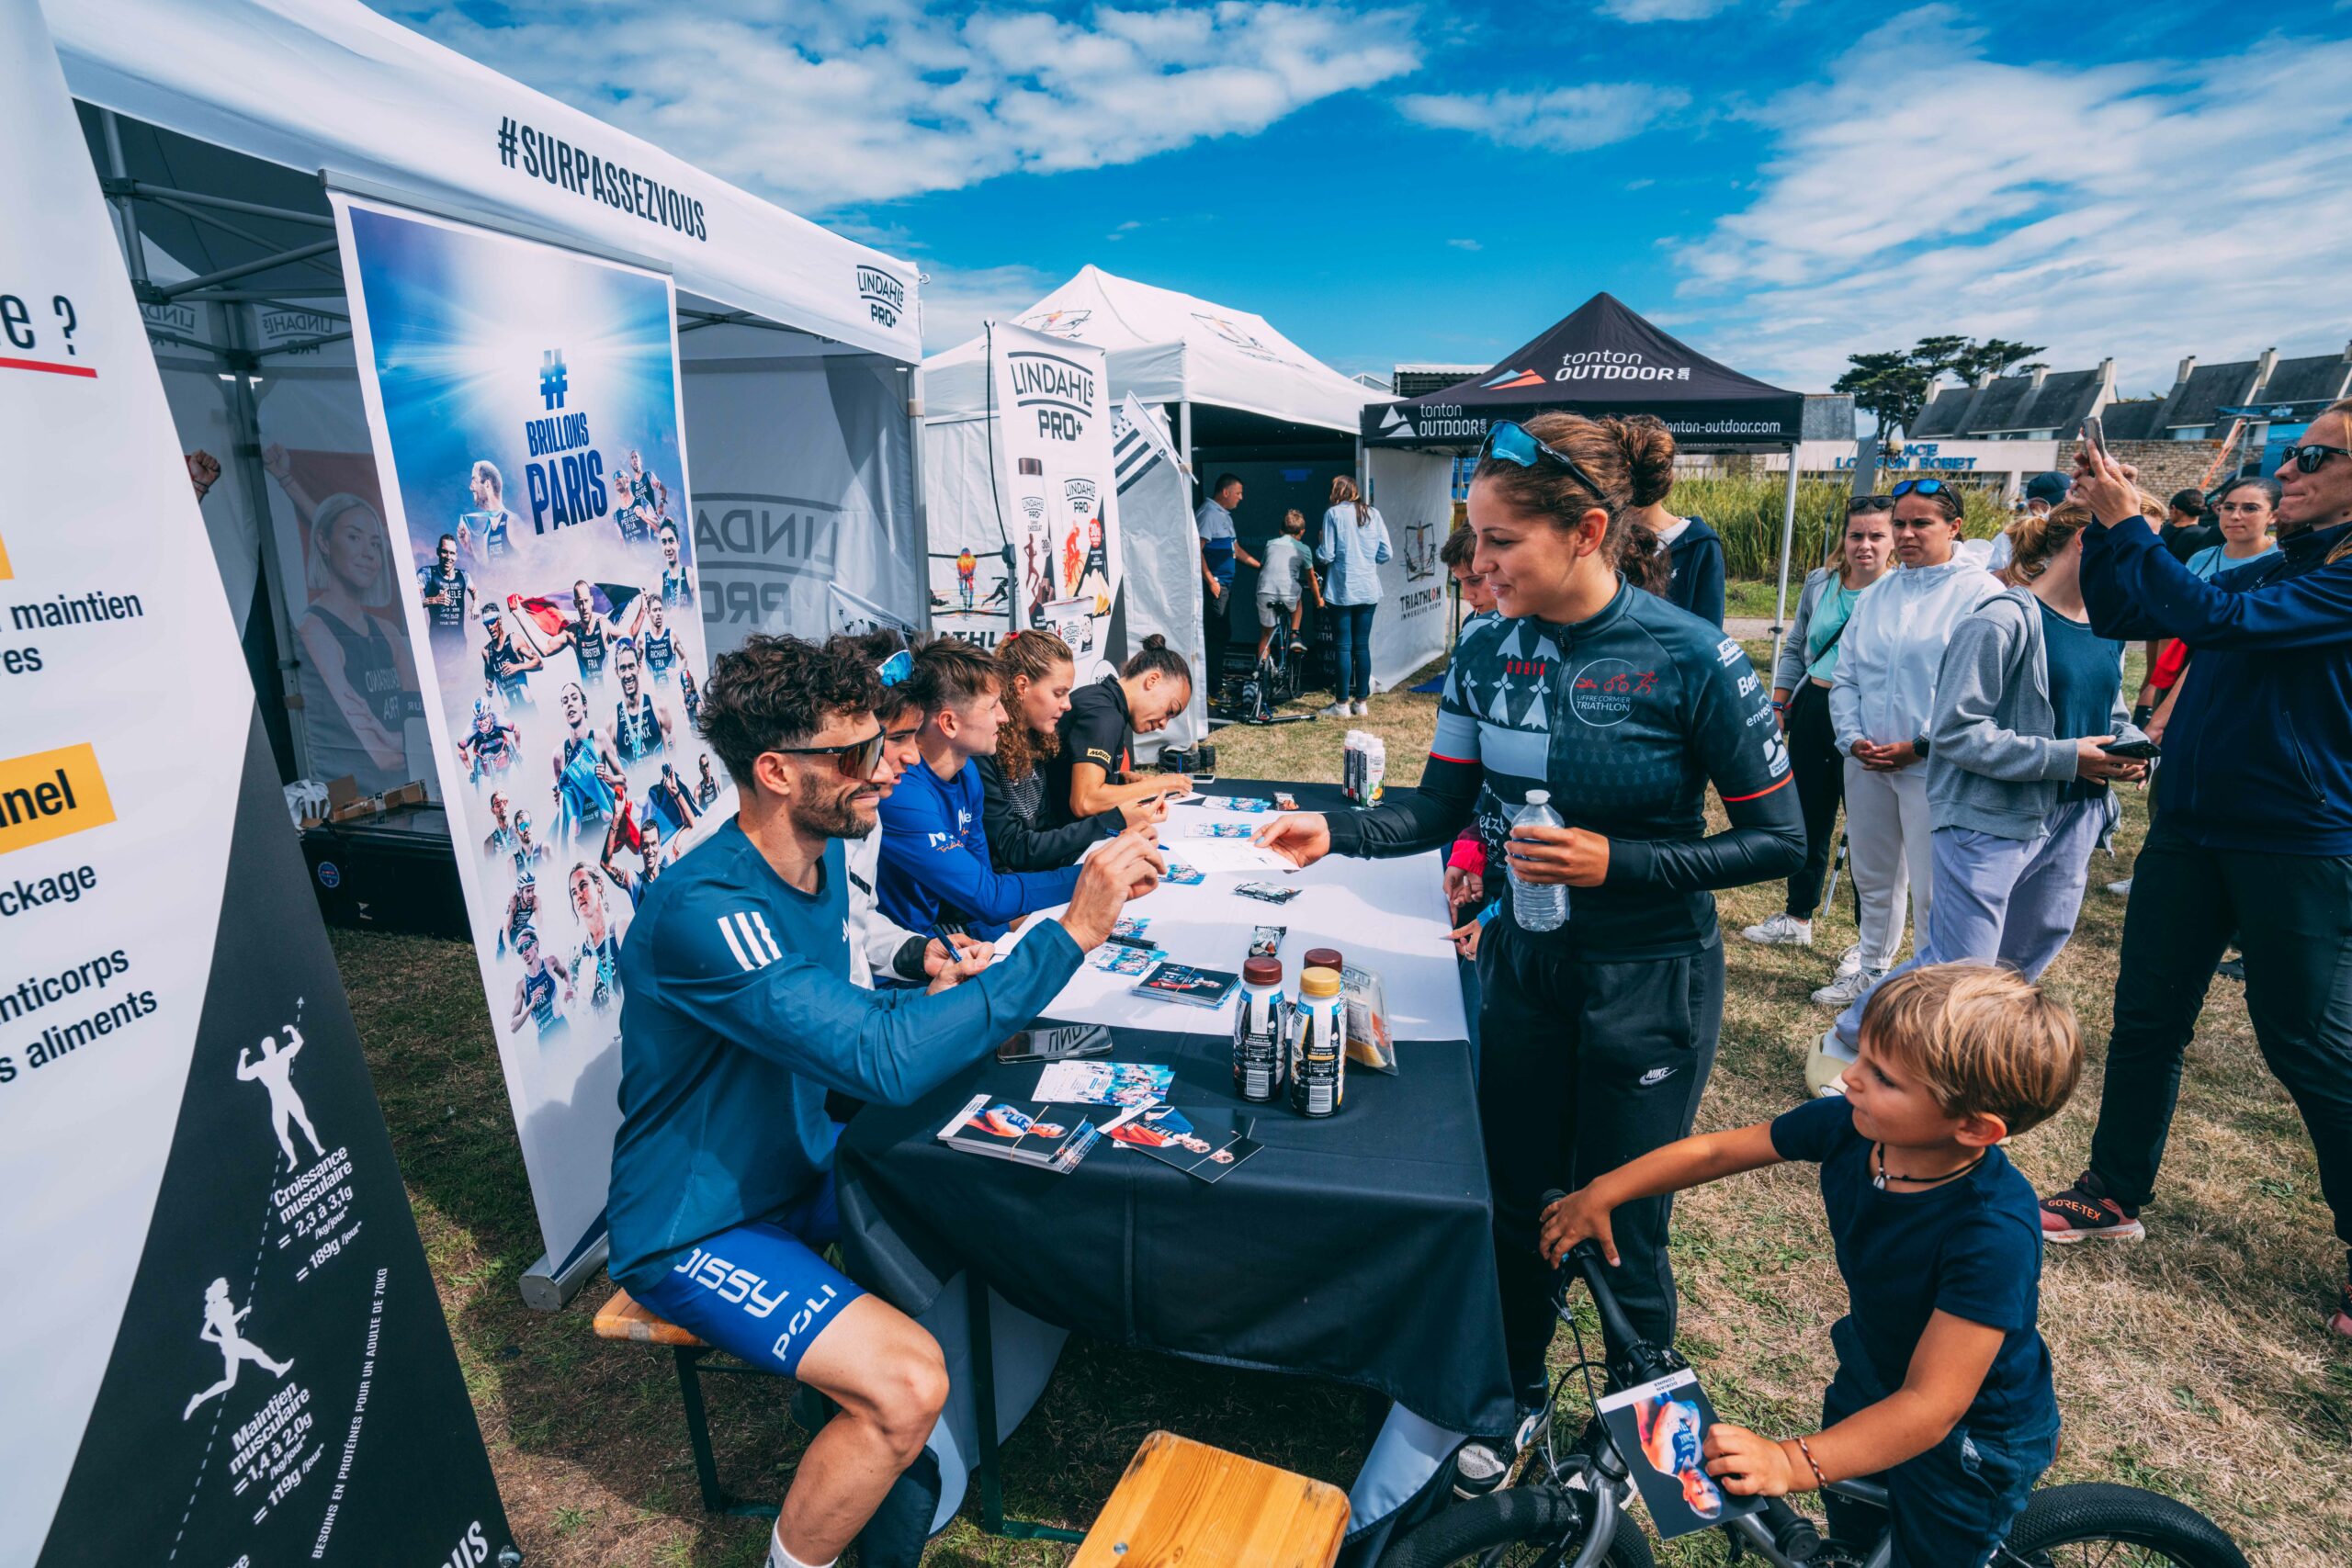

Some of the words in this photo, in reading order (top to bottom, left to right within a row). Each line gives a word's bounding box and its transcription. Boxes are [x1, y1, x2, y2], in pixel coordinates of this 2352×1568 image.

[498, 116, 707, 242] #SURPASSEZVOUS
[857, 272, 904, 308] LINDAHLS
[53, 295, 77, 355] ?
[871, 303, 897, 328] PRO+
[1555, 366, 1674, 381] OUTDOOR
[1563, 350, 1642, 366] tonton
[1011, 362, 1093, 408] LINDAHLS
[1038, 409, 1083, 442] PRO+
[1419, 403, 1462, 417] tonton
[526, 412, 590, 457] BRILLONS
[1419, 420, 1478, 436] OUTDOOR
[1836, 457, 1911, 469] LOSON
[1918, 457, 1977, 469] BOBET
[1876, 443, 1939, 457] EACE
[526, 449, 608, 536] PARIS
[10, 591, 143, 630] maintien
[1400, 586, 1441, 612] TRIATHLON
[0, 647, 43, 674] es
[650, 649, 668, 659] RICHARD
[655, 659, 665, 668] FRA
[1506, 660, 1546, 676] GOBIK
[1577, 701, 1631, 712] TRIATHLON
[0, 769, 76, 828] nel
[0, 865, 96, 917] ckage
[597, 989, 610, 1003] FR
[26, 990, 157, 1068] aliments
[1645, 1067, 1668, 1079] NIKE
[275, 1146, 348, 1208] Croissance
[279, 1161, 353, 1224] musculaire
[295, 1211, 318, 1238] 2,3
[318, 1202, 328, 1219] à
[328, 1186, 354, 1211] 3,1g
[2048, 1199, 2101, 1221] GORE-TEX
[309, 1238, 341, 1269] 189g
[375, 1268, 389, 1297] 70KG
[372, 1298, 384, 1314] DE
[366, 1315, 381, 1358] ADULTE
[772, 1284, 838, 1361] POLI
[363, 1360, 374, 1378] UN
[232, 1382, 297, 1442] Maintien
[355, 1381, 371, 1413] POUR
[230, 1388, 311, 1475] musculaire
[246, 1452, 271, 1483] 1,4
[271, 1441, 284, 1459] à
[282, 1412, 313, 1448] 2,0g
[337, 1416, 363, 1481] PROTÉINES
[268, 1469, 301, 1506] 119g
[332, 1483, 345, 1501] EN
[311, 1504, 339, 1560] BESOINS
